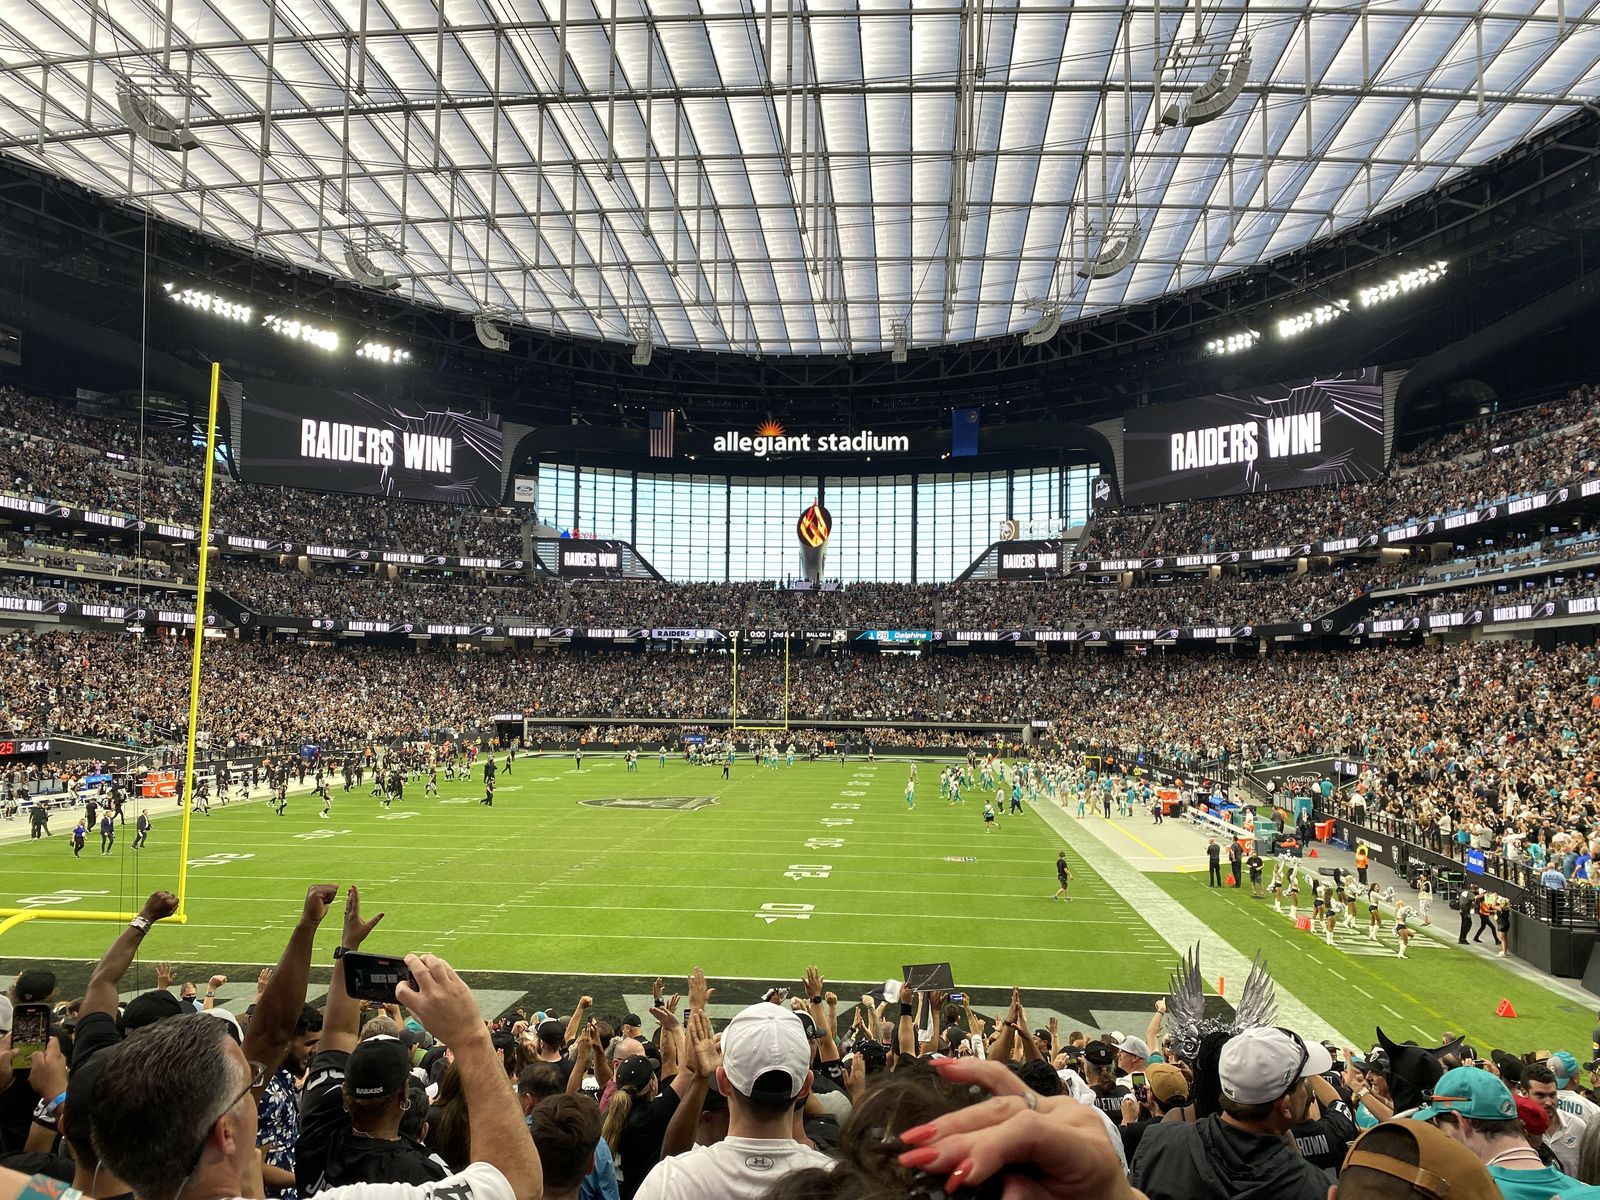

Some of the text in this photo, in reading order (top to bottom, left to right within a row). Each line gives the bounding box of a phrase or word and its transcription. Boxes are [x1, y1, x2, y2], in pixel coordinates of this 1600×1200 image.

[300, 418, 452, 474] RAIDERS WIN!
[713, 431, 909, 457] allegiant stadium
[1171, 411, 1321, 472] RAIDERS WIN!
[564, 552, 618, 567] RAIDERS WIN!
[1003, 553, 1057, 569] RAIDERS WIN!
[20, 741, 50, 752] 2nd & 4
[783, 864, 833, 878] 20
[16, 890, 111, 904] 10
[754, 902, 816, 920] 10
[356, 1086, 384, 1094] RAIDERS
[1556, 1098, 1583, 1116] RINO
[1296, 1134, 1330, 1157] ROWN
